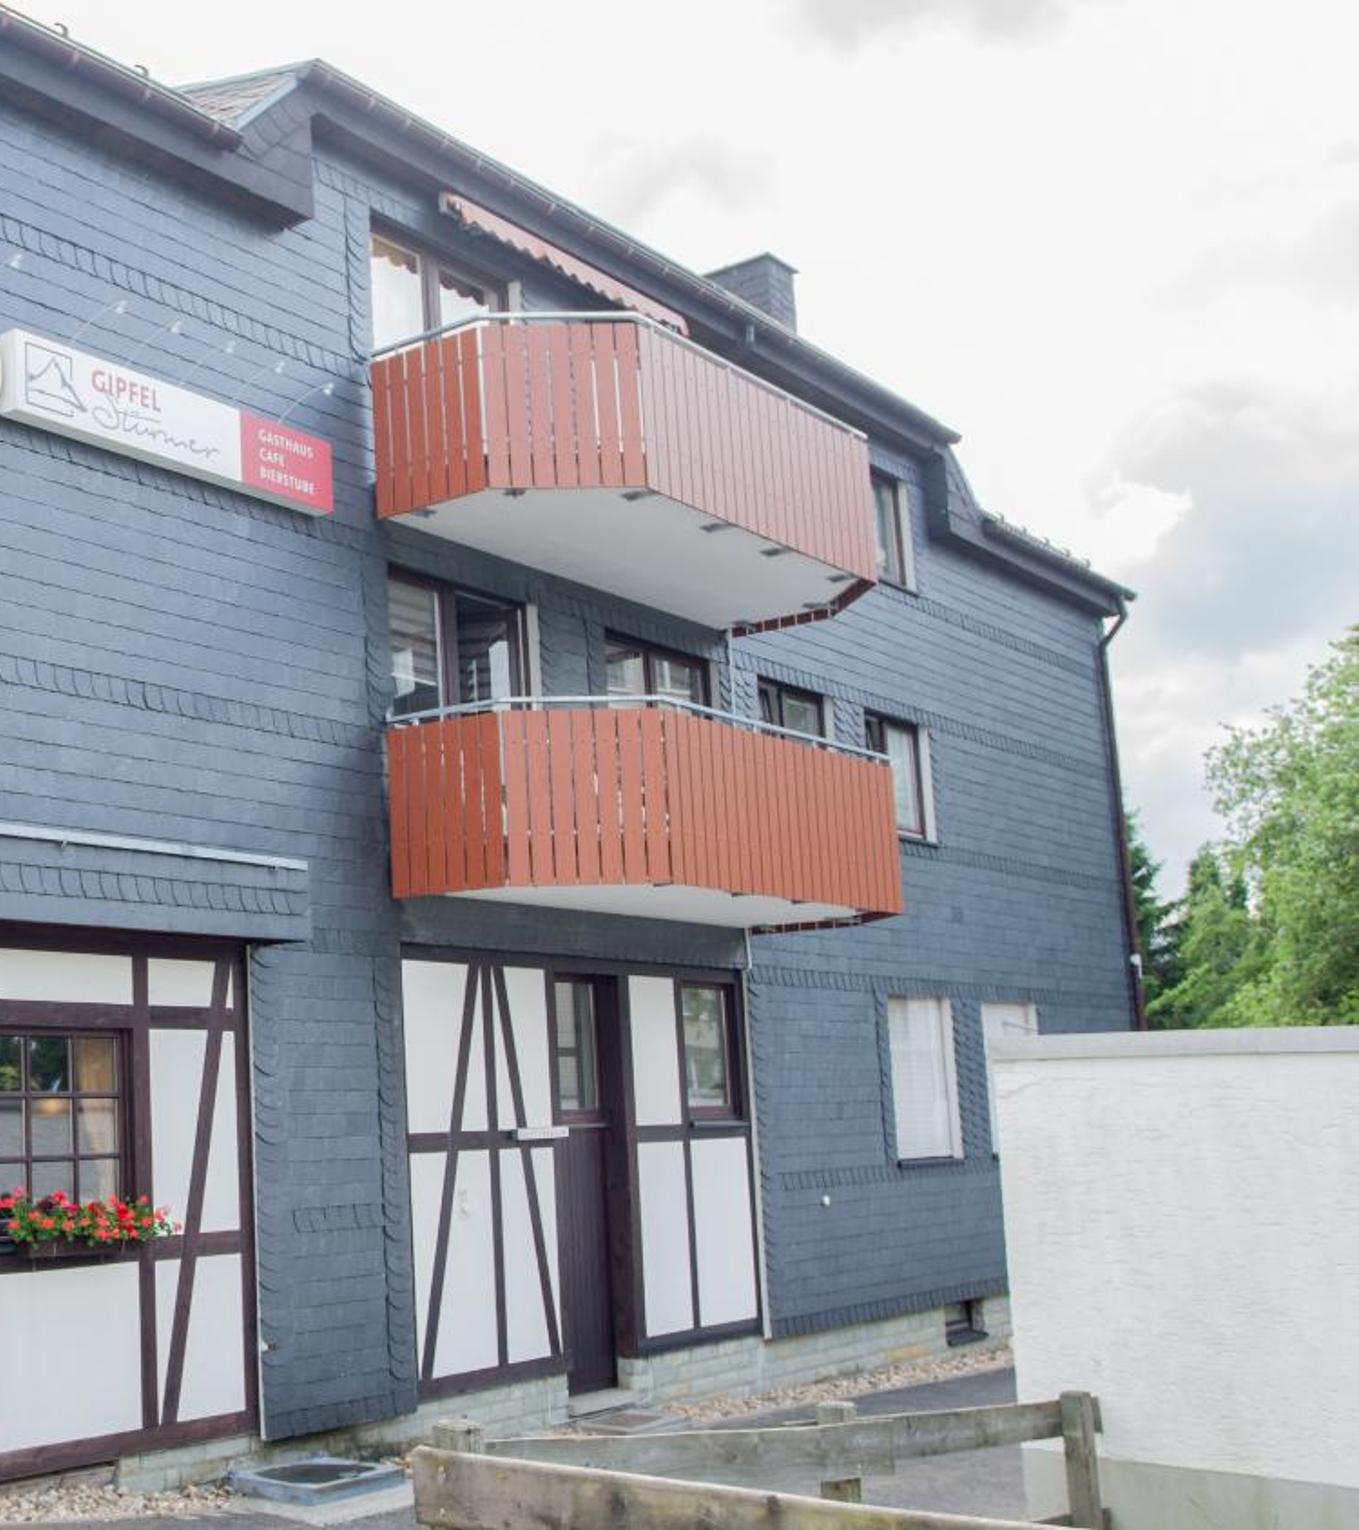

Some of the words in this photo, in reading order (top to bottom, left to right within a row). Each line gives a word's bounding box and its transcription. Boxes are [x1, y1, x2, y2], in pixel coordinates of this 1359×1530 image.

[91, 369, 162, 413] GIPFEL
[257, 428, 315, 459] GASTHAUS
[259, 447, 285, 468] CAFE
[259, 465, 315, 496] BIERSTUBE
